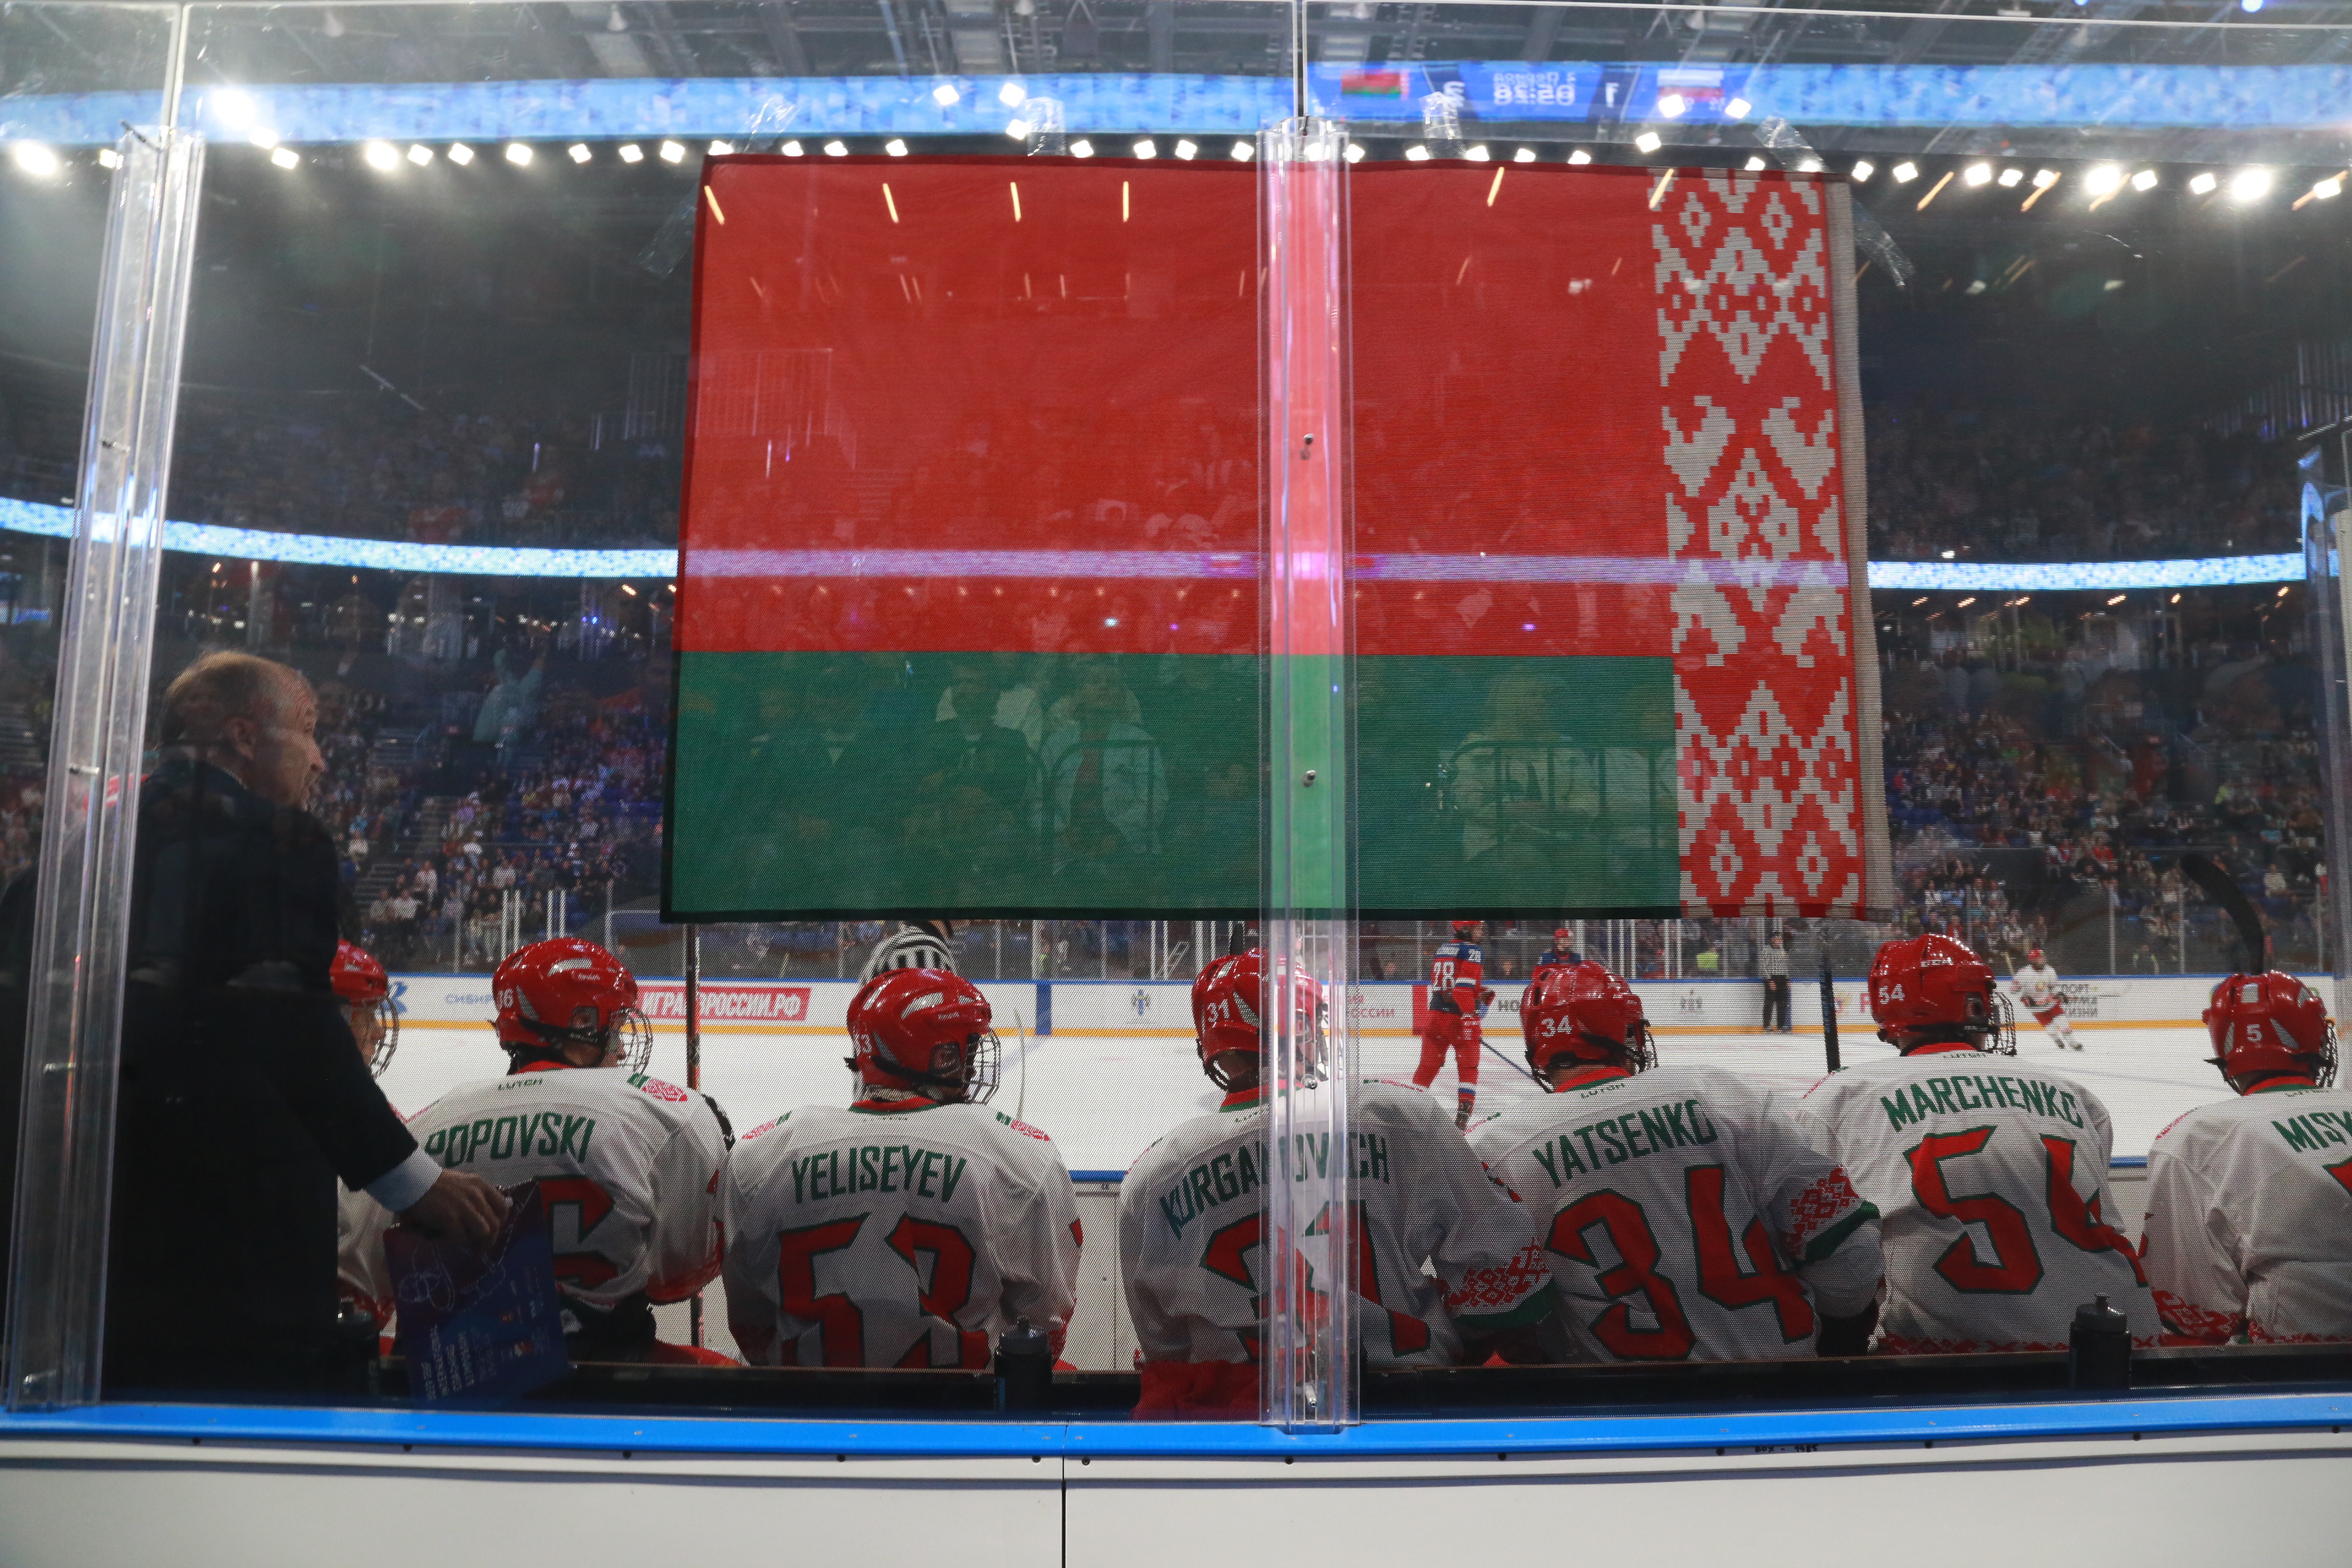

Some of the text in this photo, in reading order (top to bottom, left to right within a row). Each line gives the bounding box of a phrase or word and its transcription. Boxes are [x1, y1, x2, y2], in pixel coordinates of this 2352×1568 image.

[1432, 960, 1456, 991] 28
[642, 991, 801, 1017] ИГРАРОССИИ.РФ
[1879, 983, 1905, 1005] 54
[1207, 998, 1231, 1023] 31
[1540, 1015, 1572, 1038] 34
[2247, 1025, 2262, 1041] 5
[1880, 1075, 2083, 1133] MARCHENKO
[424, 1112, 595, 1168] POPOVSKI
[1533, 1099, 1718, 1188] YATSENKO
[791, 1145, 967, 1204] YELISEYEV
[1544, 1163, 1815, 1360] 34
